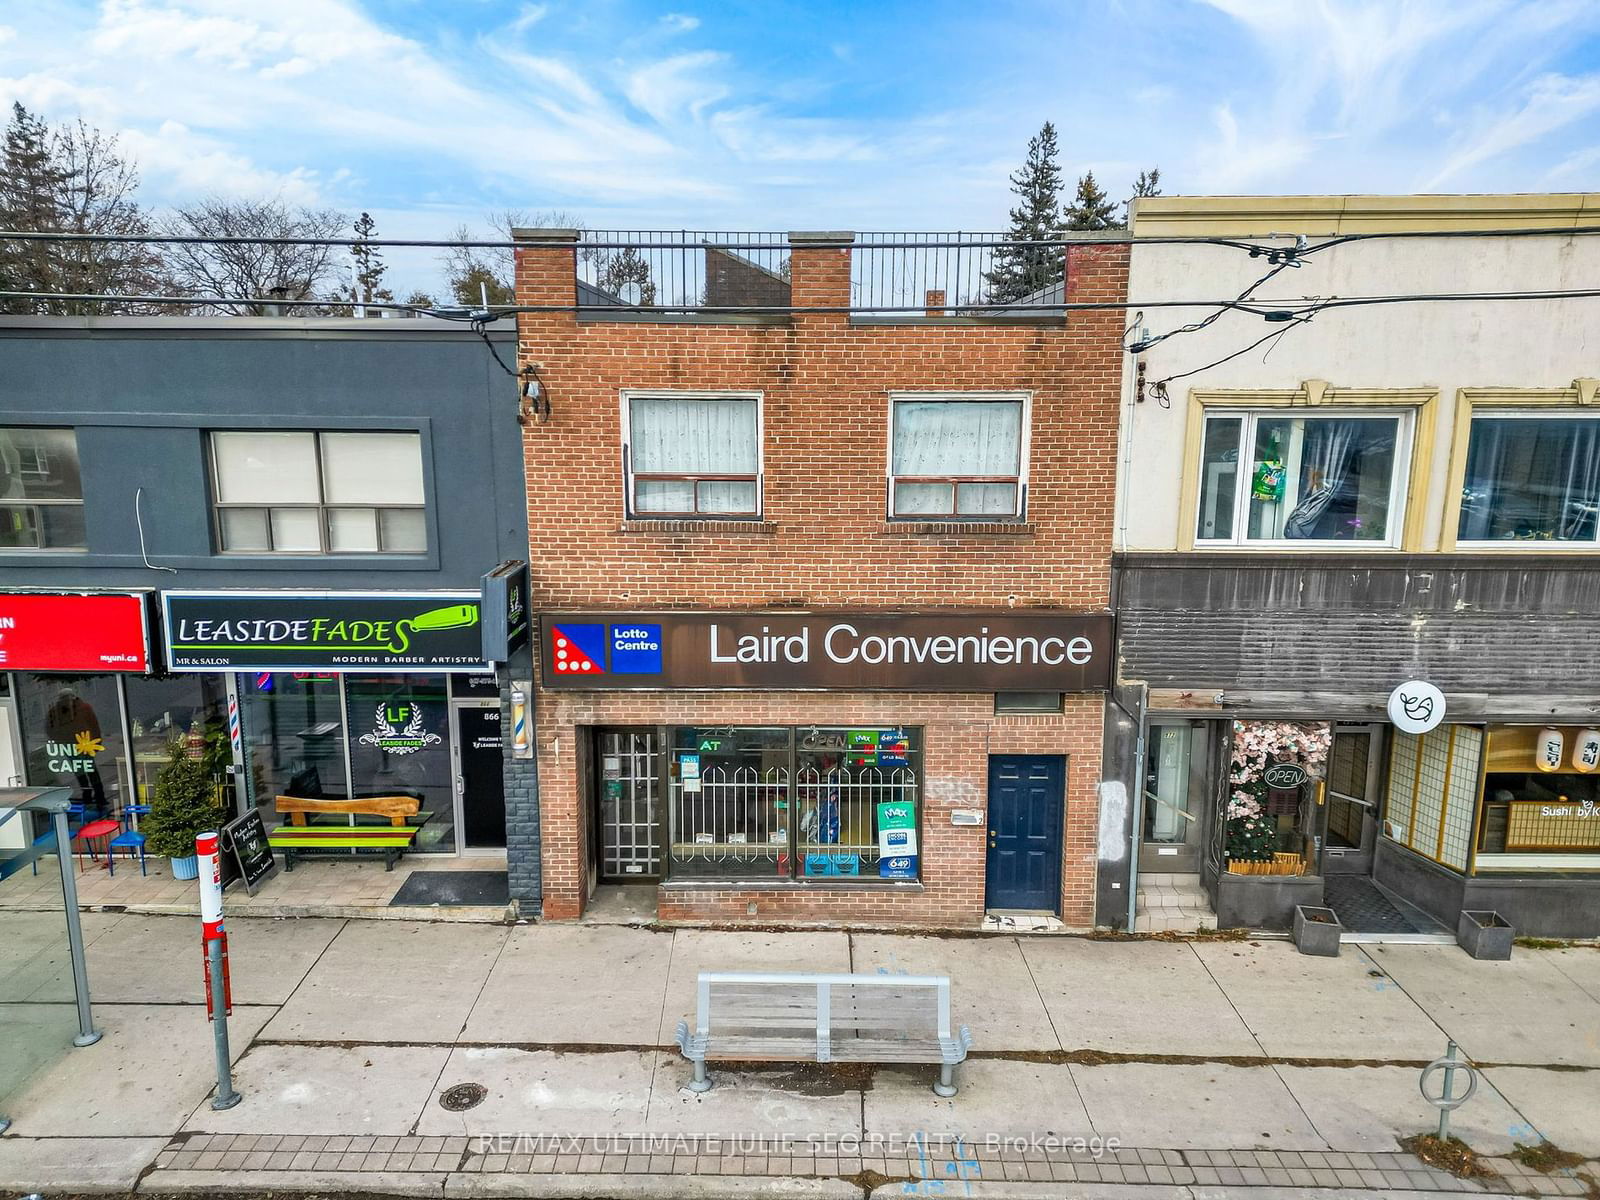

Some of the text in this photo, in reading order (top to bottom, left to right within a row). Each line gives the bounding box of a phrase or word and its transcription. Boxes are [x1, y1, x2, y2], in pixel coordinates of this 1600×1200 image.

[614, 628, 648, 639] Lotto
[615, 640, 658, 651] Centre
[709, 624, 1093, 665] Laird Convenience
[100, 654, 138, 663] myuni.ca
[191, 657, 199, 665] &
[387, 707, 409, 722] LF
[484, 713, 500, 721] 866
[48, 760, 95, 773] CAFE
[1267, 770, 1303, 783] OPEN
[1542, 806, 1572, 816] Sushi
[1577, 805, 1590, 819] by
[978, 817, 983, 825] 2
